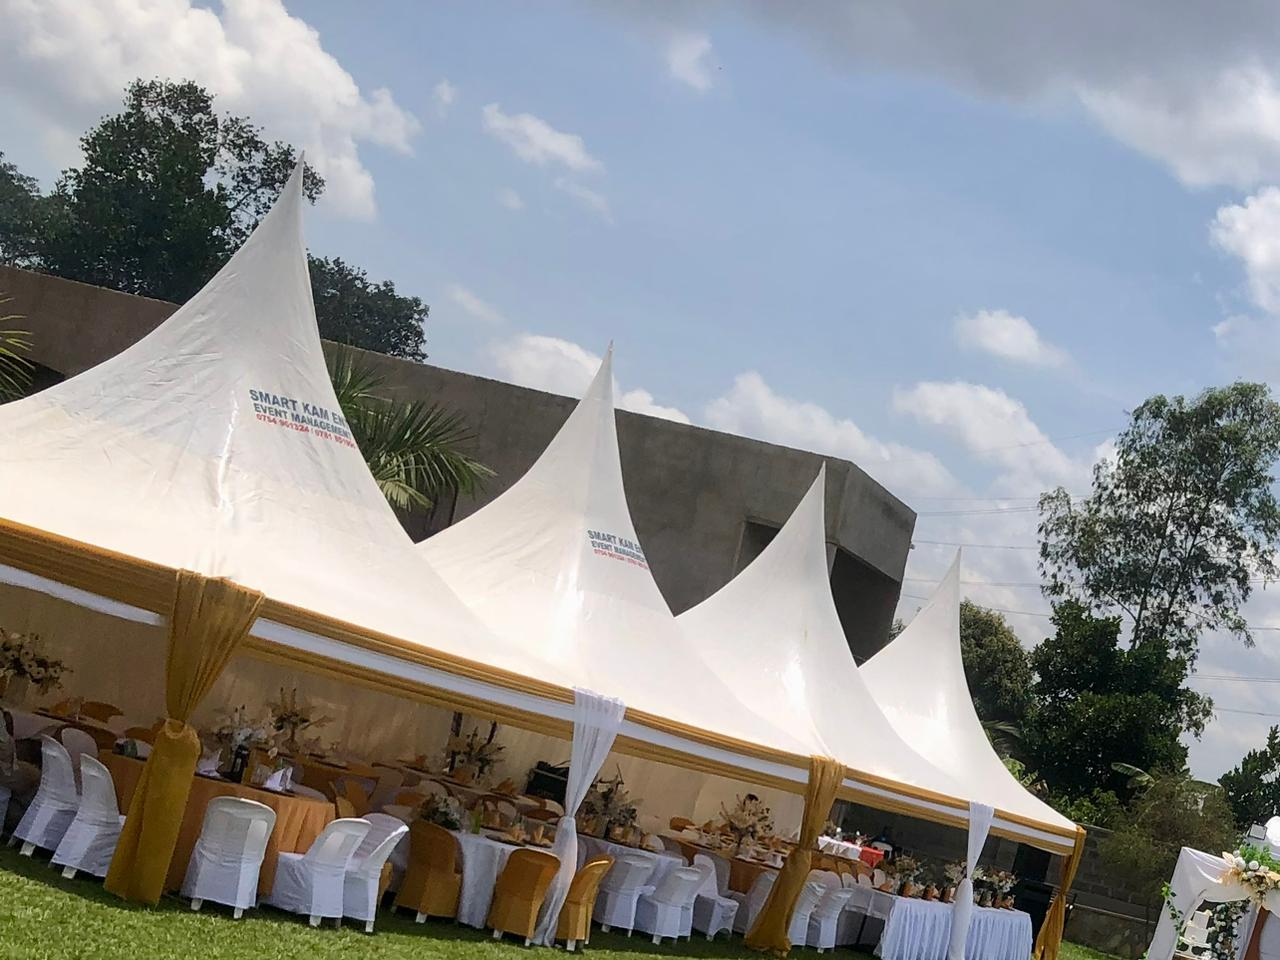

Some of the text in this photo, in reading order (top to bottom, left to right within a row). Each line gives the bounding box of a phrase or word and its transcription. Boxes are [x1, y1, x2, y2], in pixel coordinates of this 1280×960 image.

[249, 389, 298, 412] SMART
[302, 402, 330, 421] KAM
[253, 403, 288, 420] EVENT
[587, 530, 617, 545] SMART
[591, 540, 613, 552] EVENT
